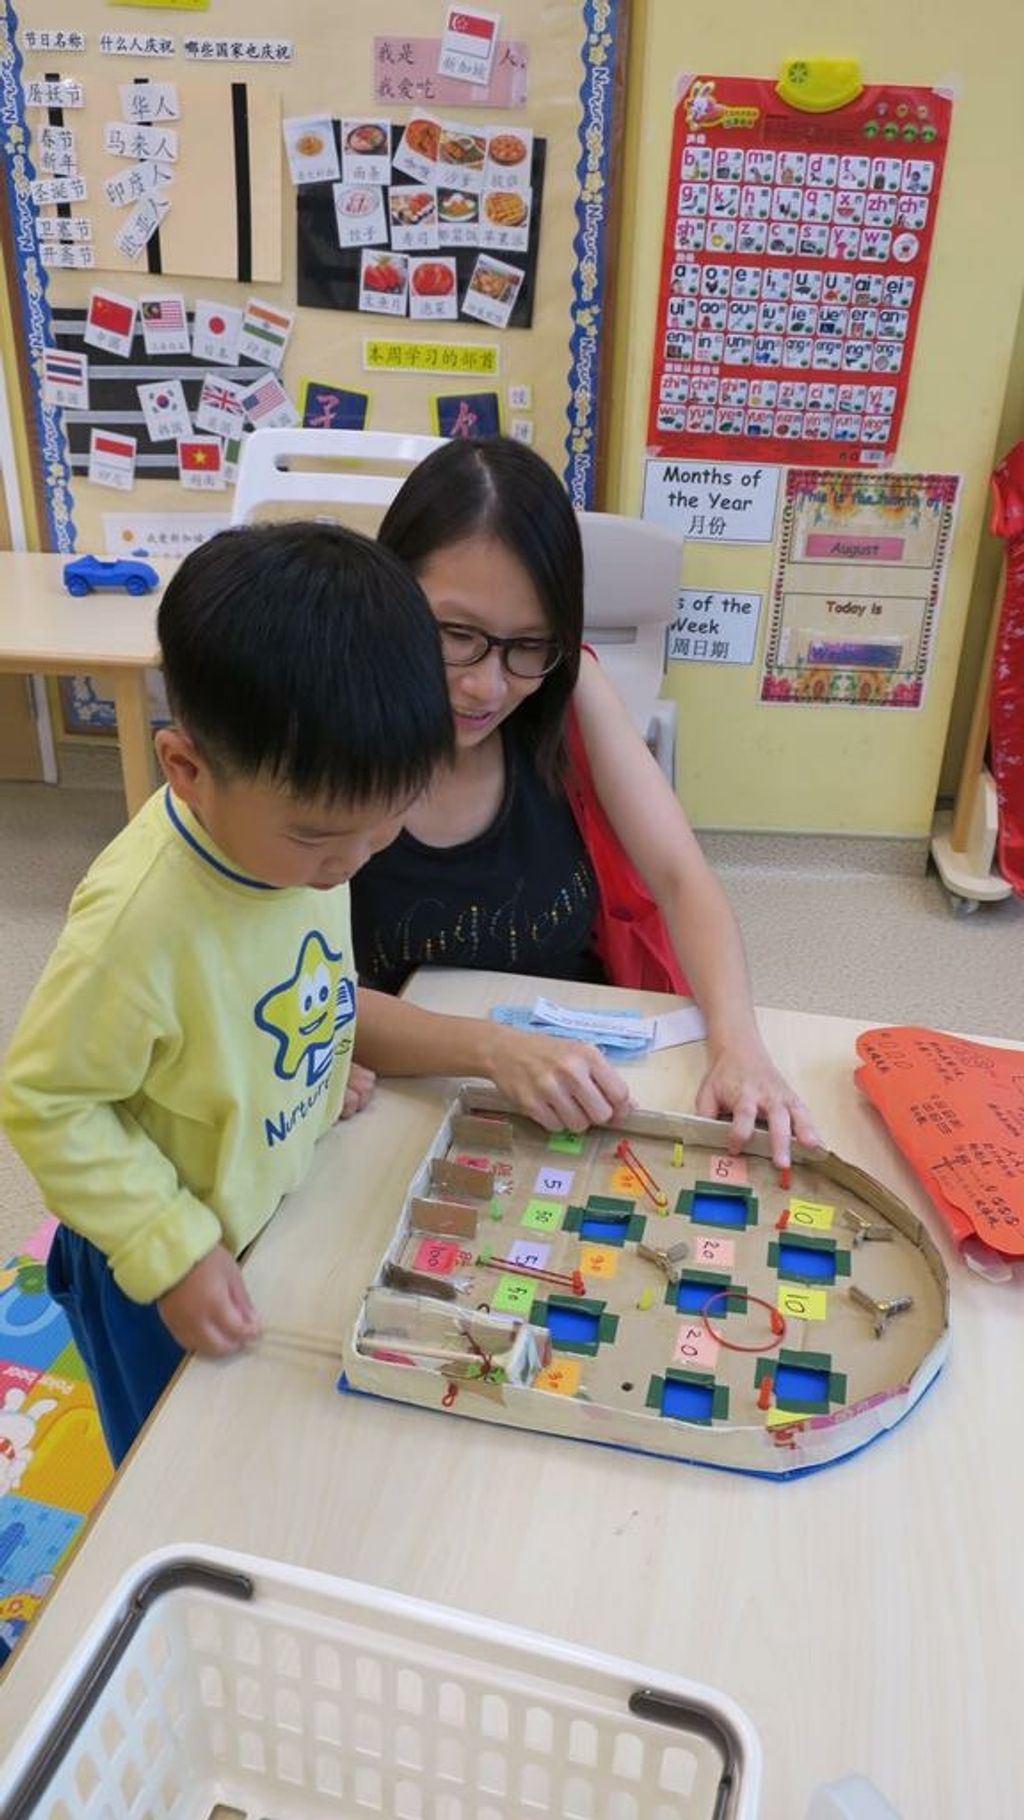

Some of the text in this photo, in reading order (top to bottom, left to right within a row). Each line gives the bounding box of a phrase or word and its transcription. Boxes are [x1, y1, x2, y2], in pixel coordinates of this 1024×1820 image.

[25, 31, 84, 48] 节日名称
[100, 35, 175, 54] 什么人庆祝
[379, 42, 414, 65] 我是
[379, 77, 436, 100] 我爱吃
[130, 94, 176, 119] 华人
[42, 128, 73, 149] 春节
[107, 131, 175, 159] 马来人
[33, 179, 85, 199] 圣诞节
[105, 164, 172, 203] 印度人
[663, 467, 763, 487] Months of
[668, 491, 753, 511] the Year
[688, 515, 727, 536] 月份
[830, 542, 880, 559] August
[693, 594, 711, 611] of
[722, 598, 752, 614] the
[826, 600, 867, 617] Today
[671, 638, 730, 659] 周日期
[715, 1158, 733, 1178] 20
[543, 1178, 563, 1190] 5
[794, 1204, 822, 1225] 10
[428, 1246, 445, 1268] 100
[702, 1240, 721, 1260] 20
[785, 1292, 810, 1314] 10
[680, 1328, 702, 1357] 20
